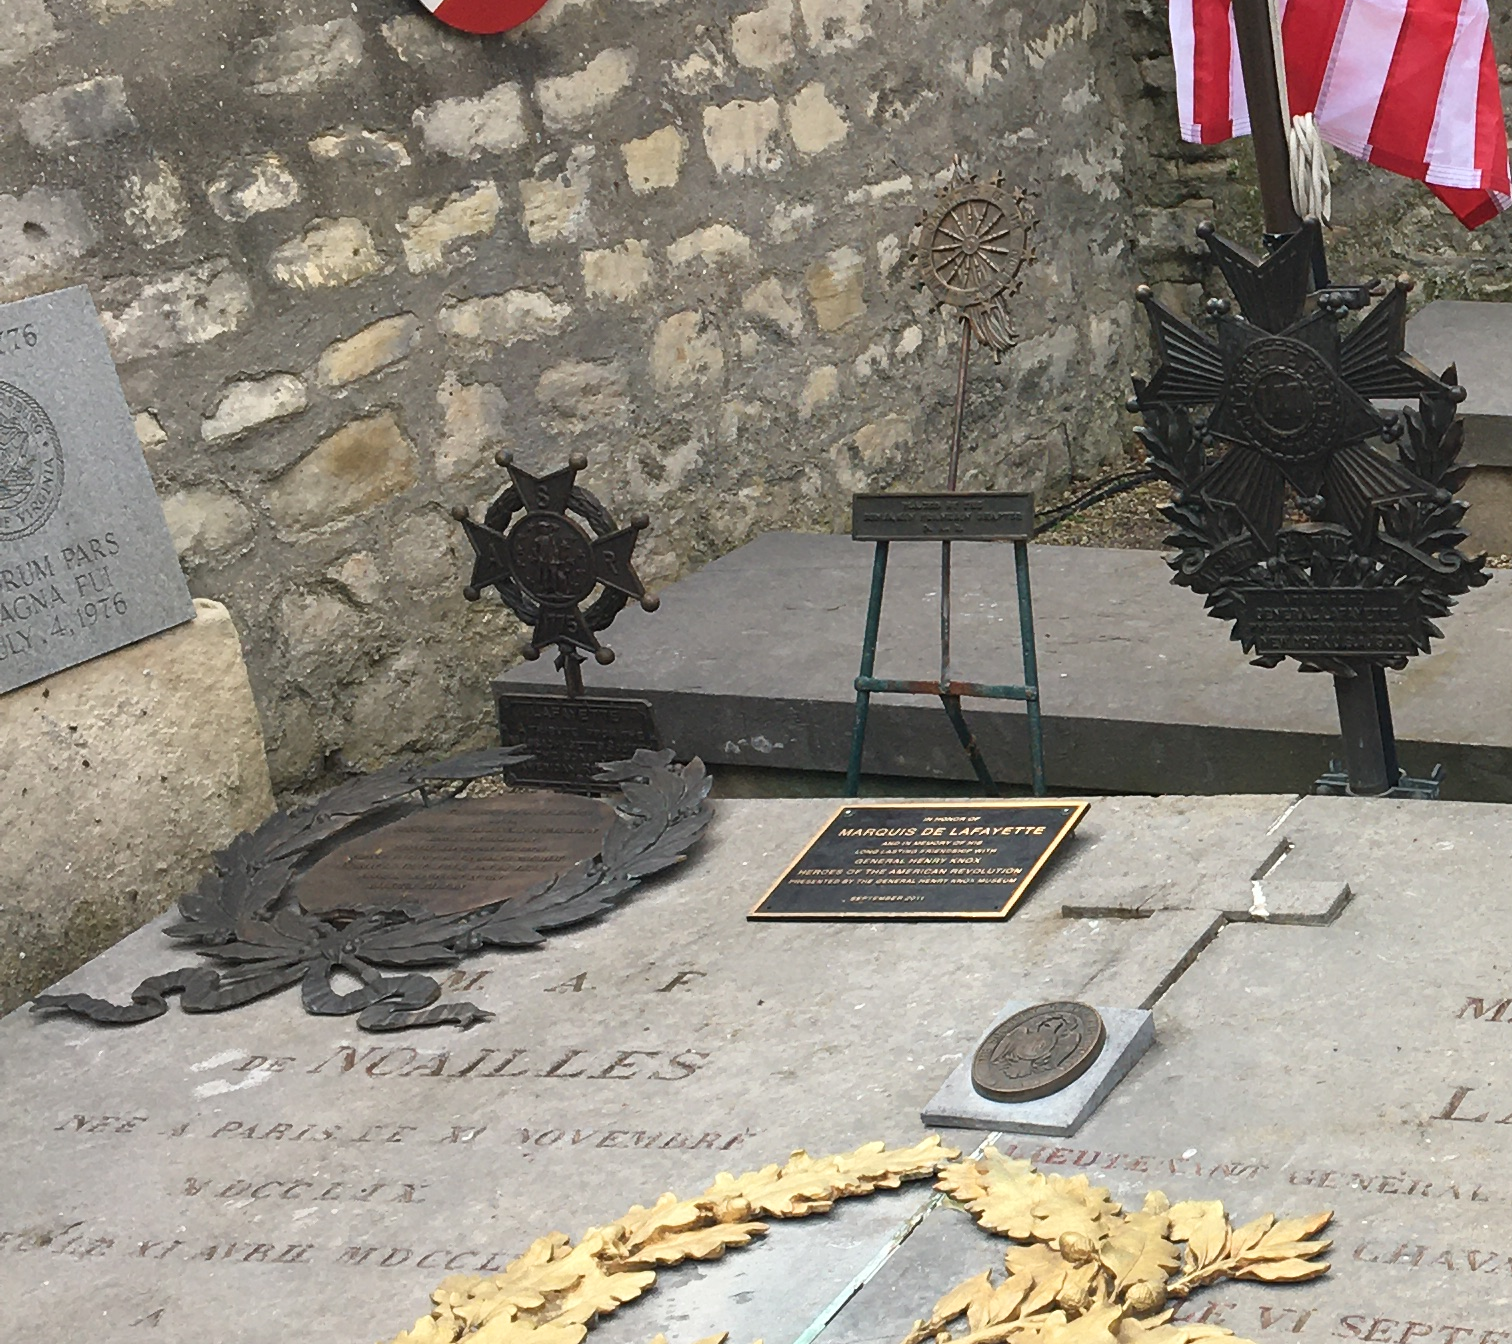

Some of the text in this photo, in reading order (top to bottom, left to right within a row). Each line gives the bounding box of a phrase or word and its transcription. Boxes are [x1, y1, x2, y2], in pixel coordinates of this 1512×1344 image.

[61, 532, 121, 571] PARS
[75, 566, 114, 598] FUI
[838, 826, 1046, 836] MARQUIS DE LAFAYETTE
